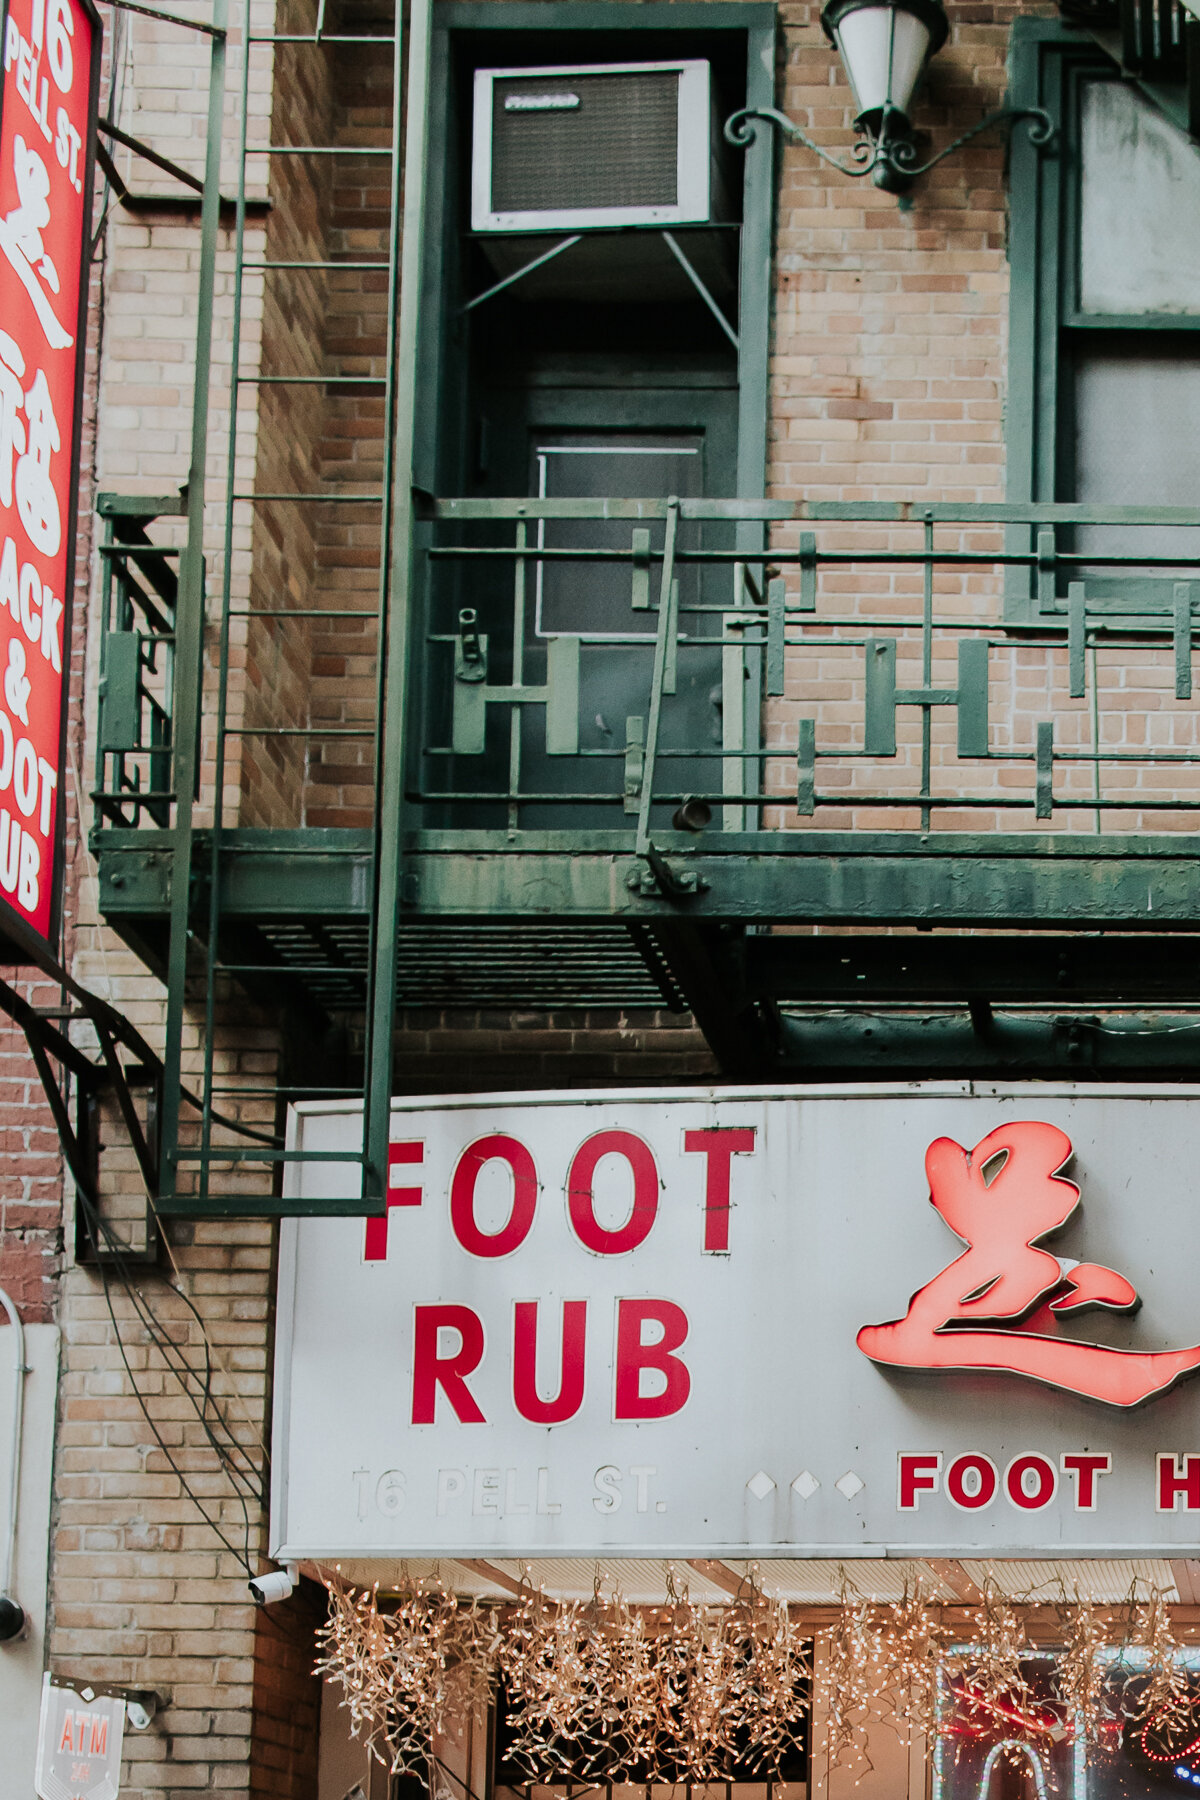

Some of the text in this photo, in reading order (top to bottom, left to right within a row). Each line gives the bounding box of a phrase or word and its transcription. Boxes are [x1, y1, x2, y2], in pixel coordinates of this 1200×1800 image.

[4, 14, 82, 194] PELL ST.
[0, 535, 63, 675] ACK
[4, 636, 32, 728] &
[0, 808, 41, 913] UB
[361, 1127, 758, 1264] FOOT
[409, 1296, 694, 1427] RUB
[352, 1464, 669, 1519] 16 PELL ST.
[896, 1450, 1113, 1514] FOOT
[57, 1708, 110, 1760] ATM
